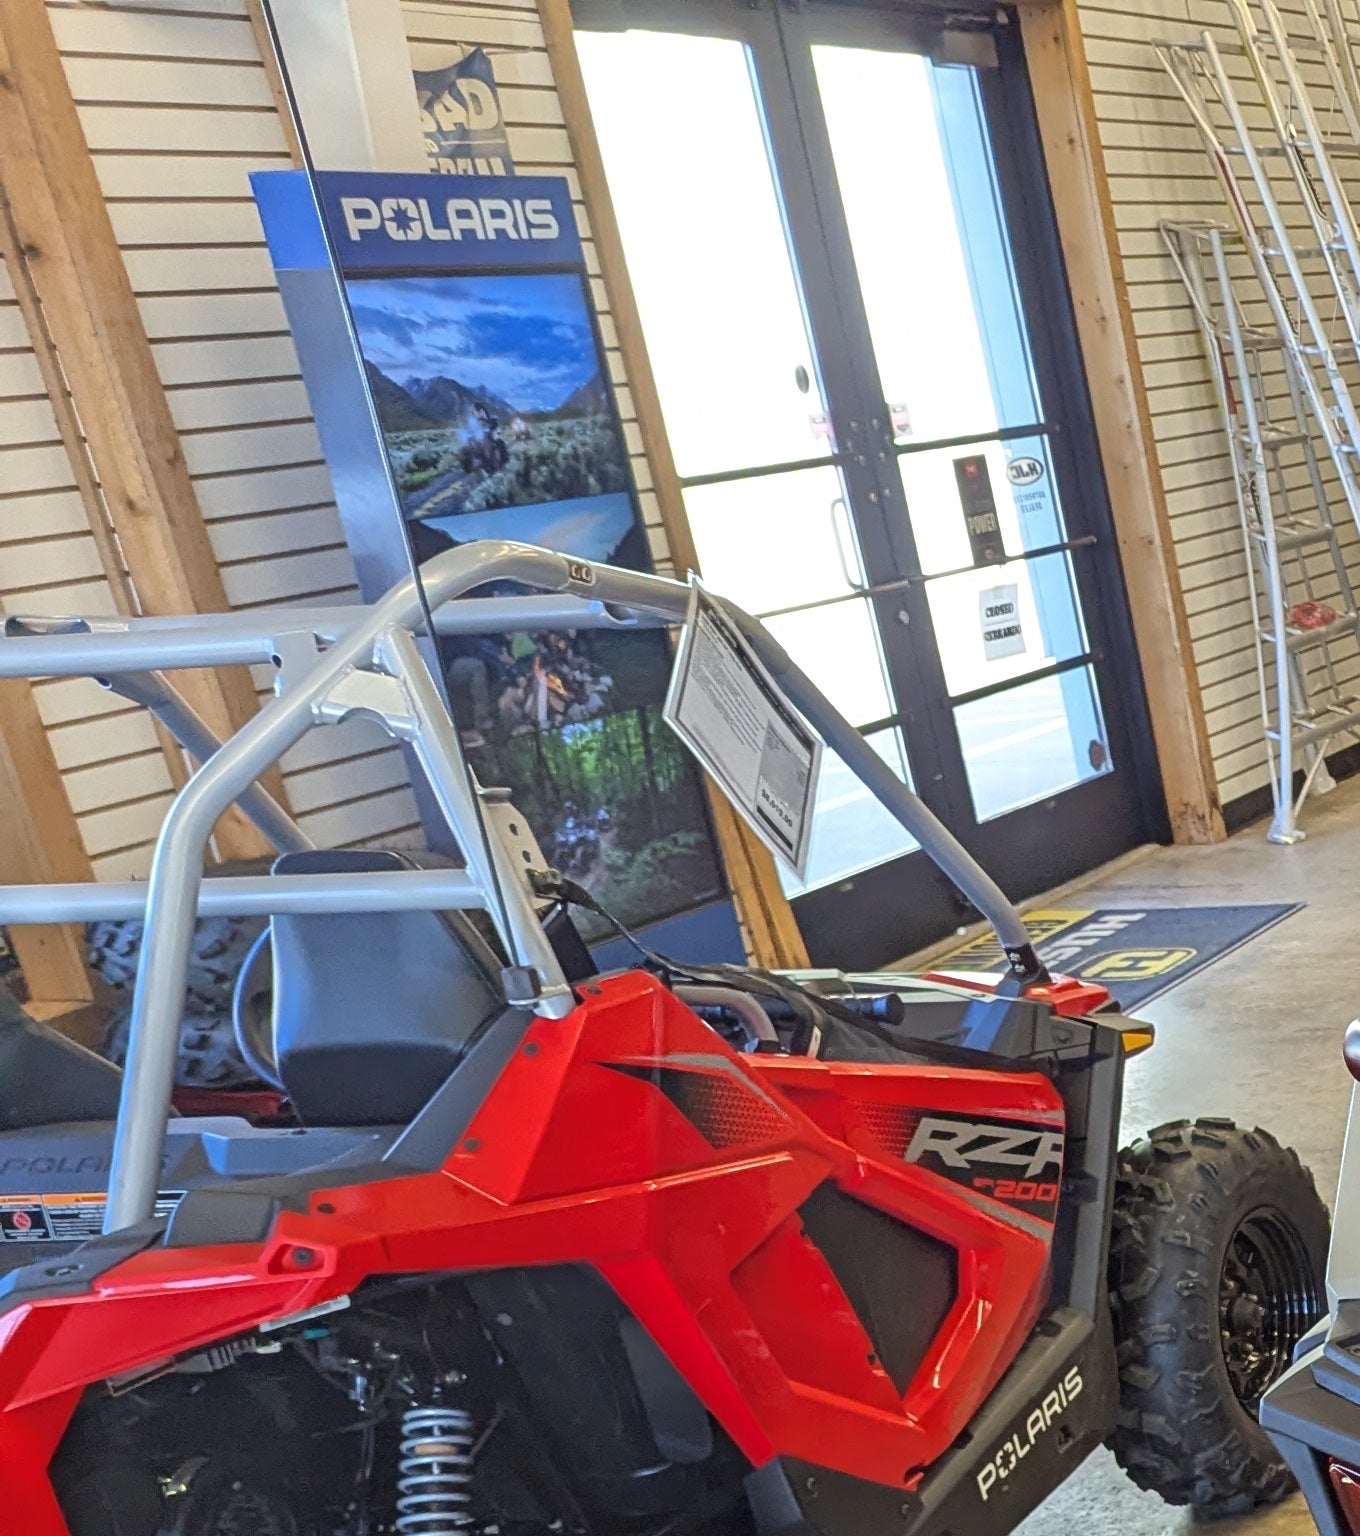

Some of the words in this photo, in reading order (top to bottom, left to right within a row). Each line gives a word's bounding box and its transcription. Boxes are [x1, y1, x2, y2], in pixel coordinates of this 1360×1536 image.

[341, 197, 559, 241] POLARIS
[968, 515, 998, 537] POWER
[994, 1180, 1058, 1200] 200
[976, 1365, 1084, 1502] POLARIS
